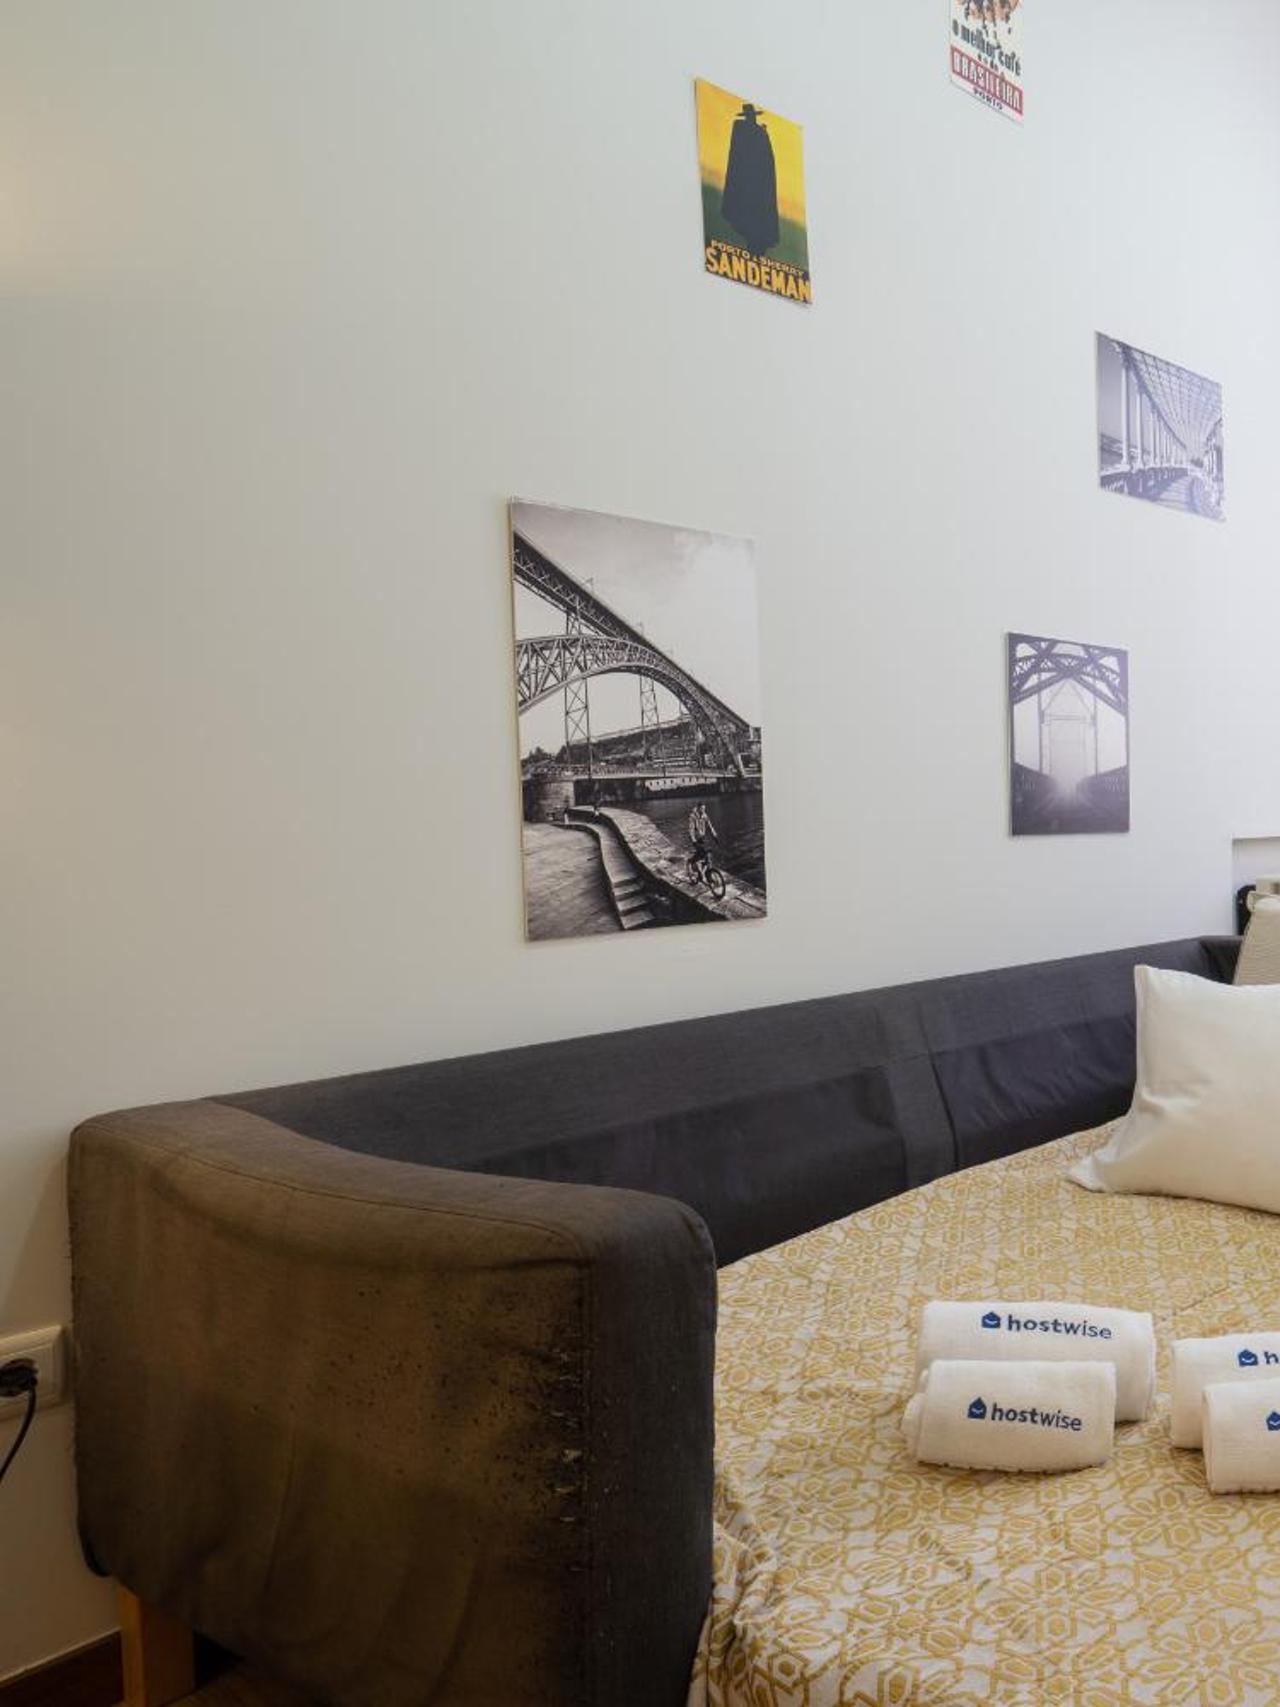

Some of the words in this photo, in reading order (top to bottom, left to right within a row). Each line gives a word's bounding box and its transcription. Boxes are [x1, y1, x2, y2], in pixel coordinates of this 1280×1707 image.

[706, 247, 811, 302] SANDEMAN
[1007, 1314, 1112, 1339] hostwise
[991, 1403, 1082, 1431] hostwise
